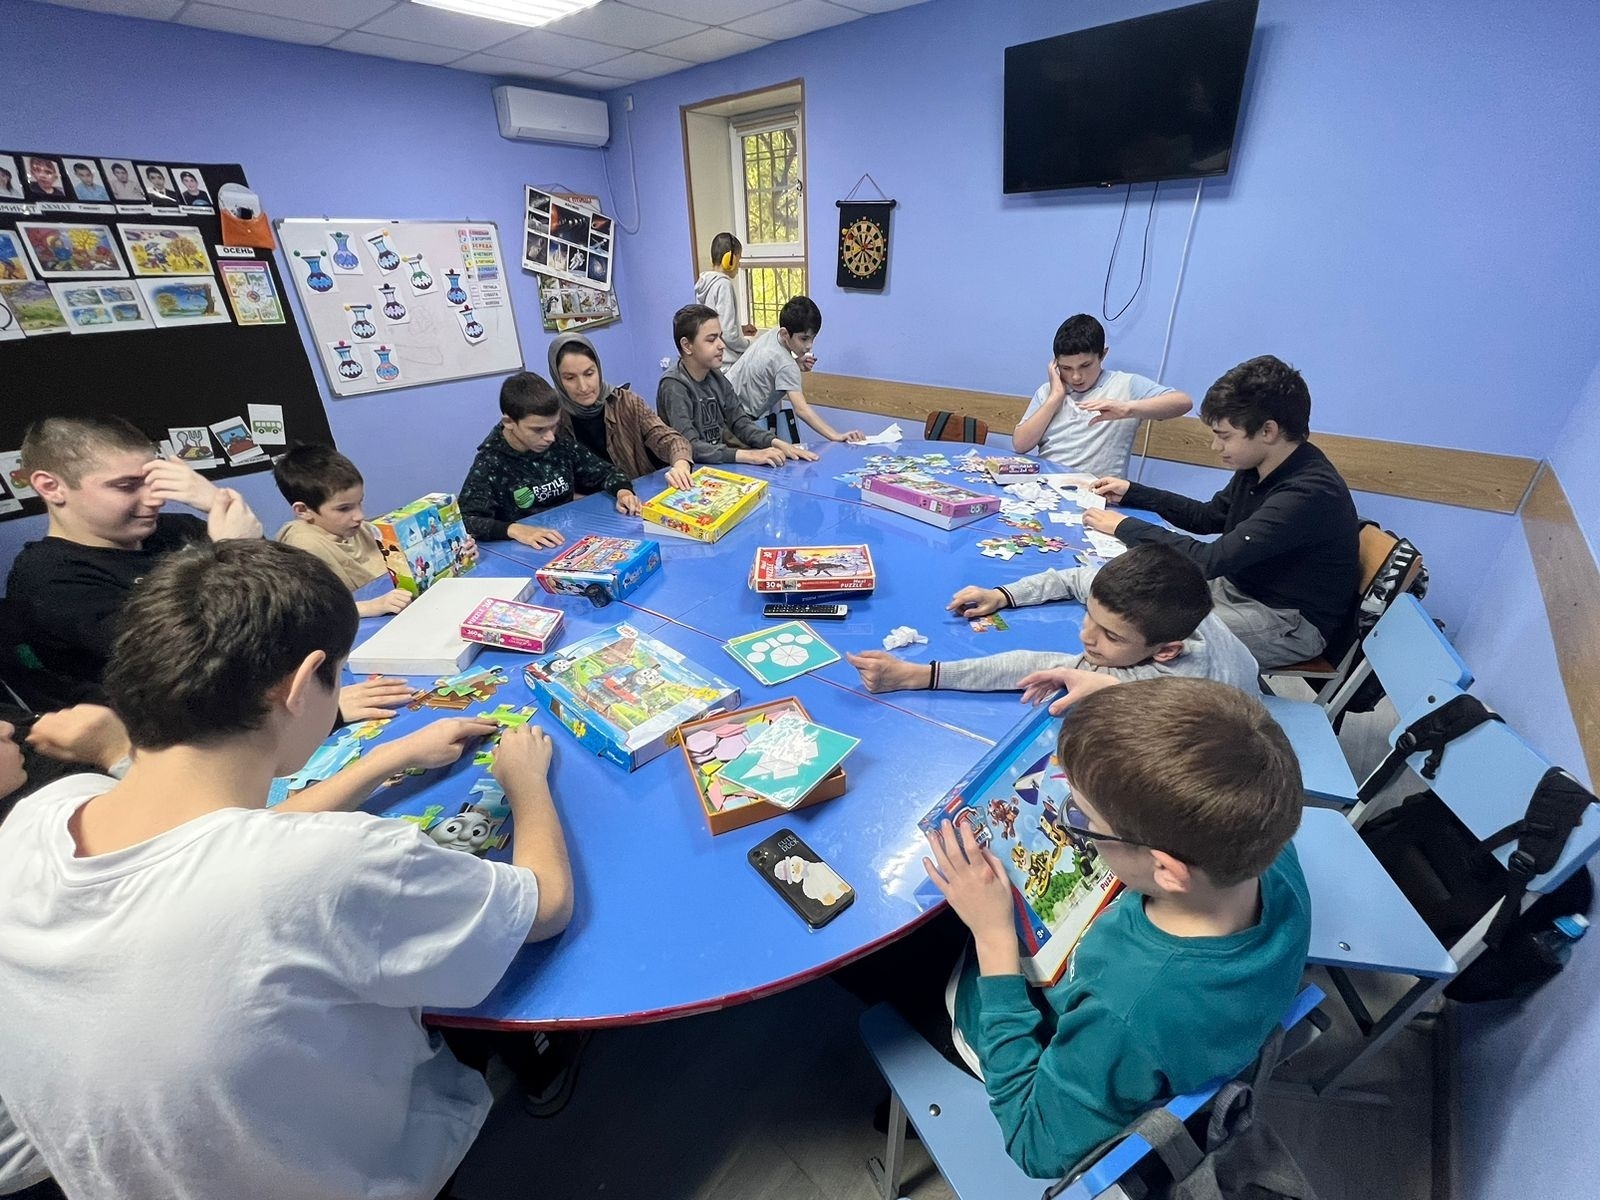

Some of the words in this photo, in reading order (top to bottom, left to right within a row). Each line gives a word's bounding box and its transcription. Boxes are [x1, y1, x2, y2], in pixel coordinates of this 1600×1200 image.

[532, 476, 566, 496] R-STYLE
[537, 482, 570, 502] SOFTLAB
[777, 834, 796, 848] CUTE
[781, 838, 799, 852] DUCK
